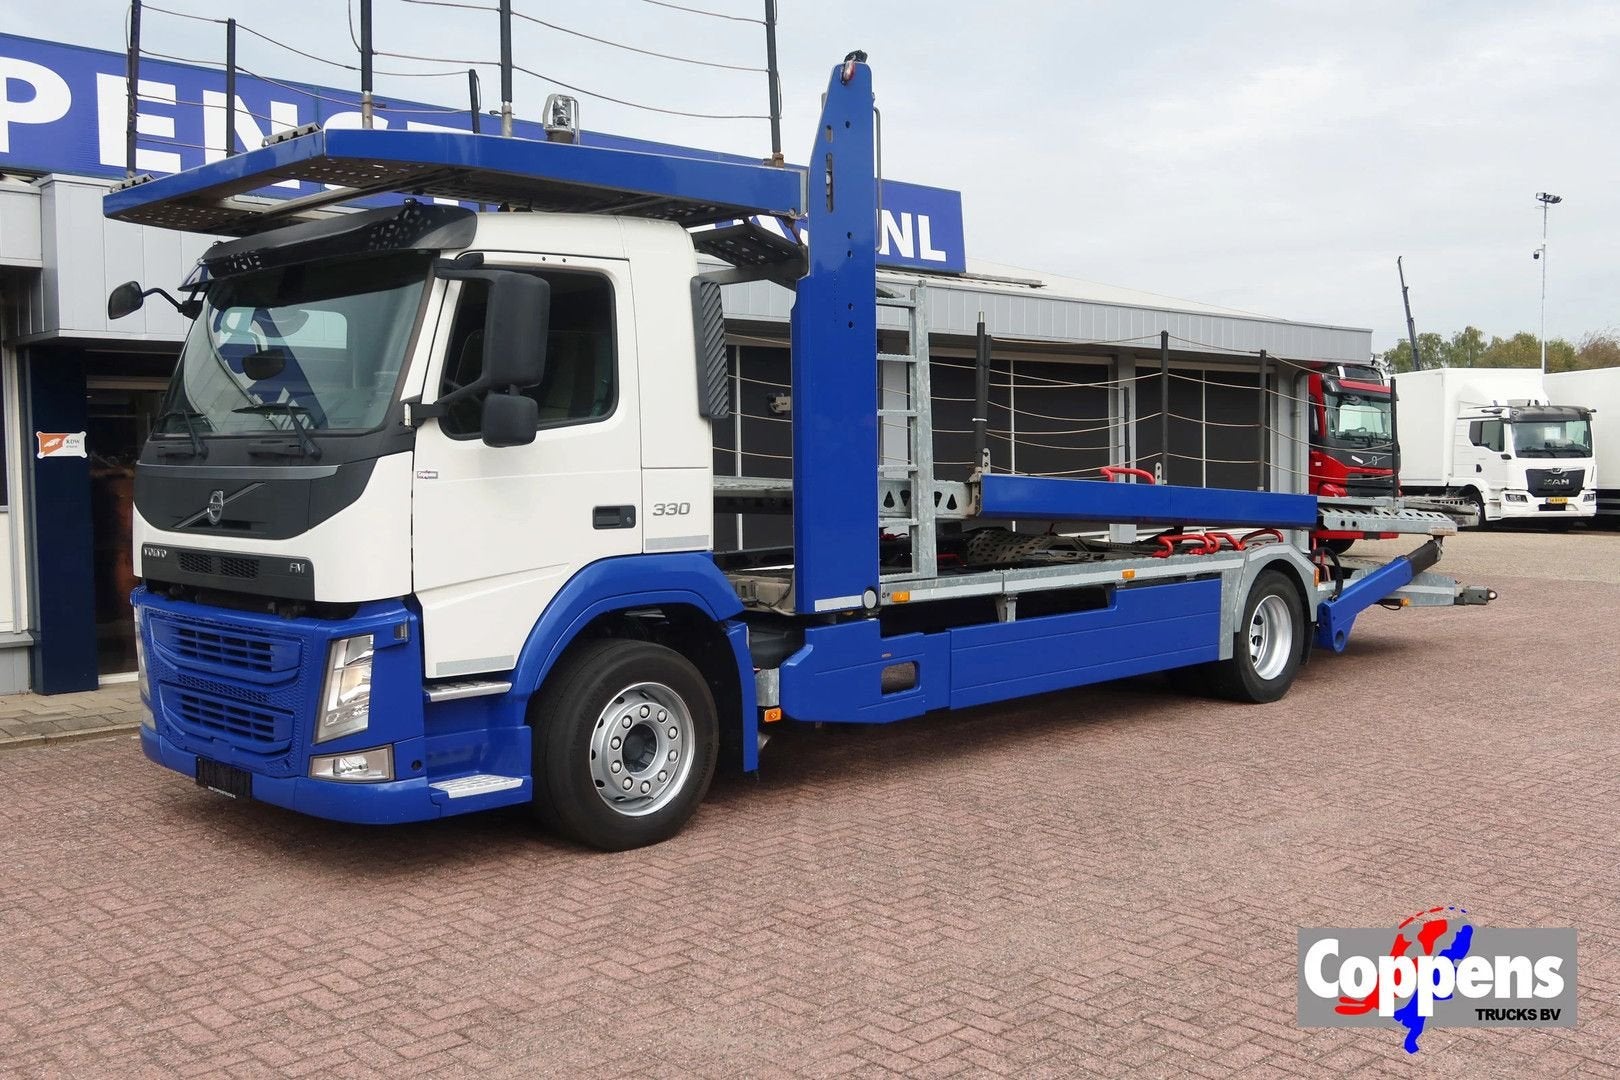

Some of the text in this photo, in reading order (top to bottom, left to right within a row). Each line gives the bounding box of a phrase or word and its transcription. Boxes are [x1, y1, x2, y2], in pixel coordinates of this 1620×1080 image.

[0, 57, 390, 190] PEN
[652, 503, 691, 516] 330
[144, 548, 167, 558] VOLVO
[290, 563, 305, 573] FM
